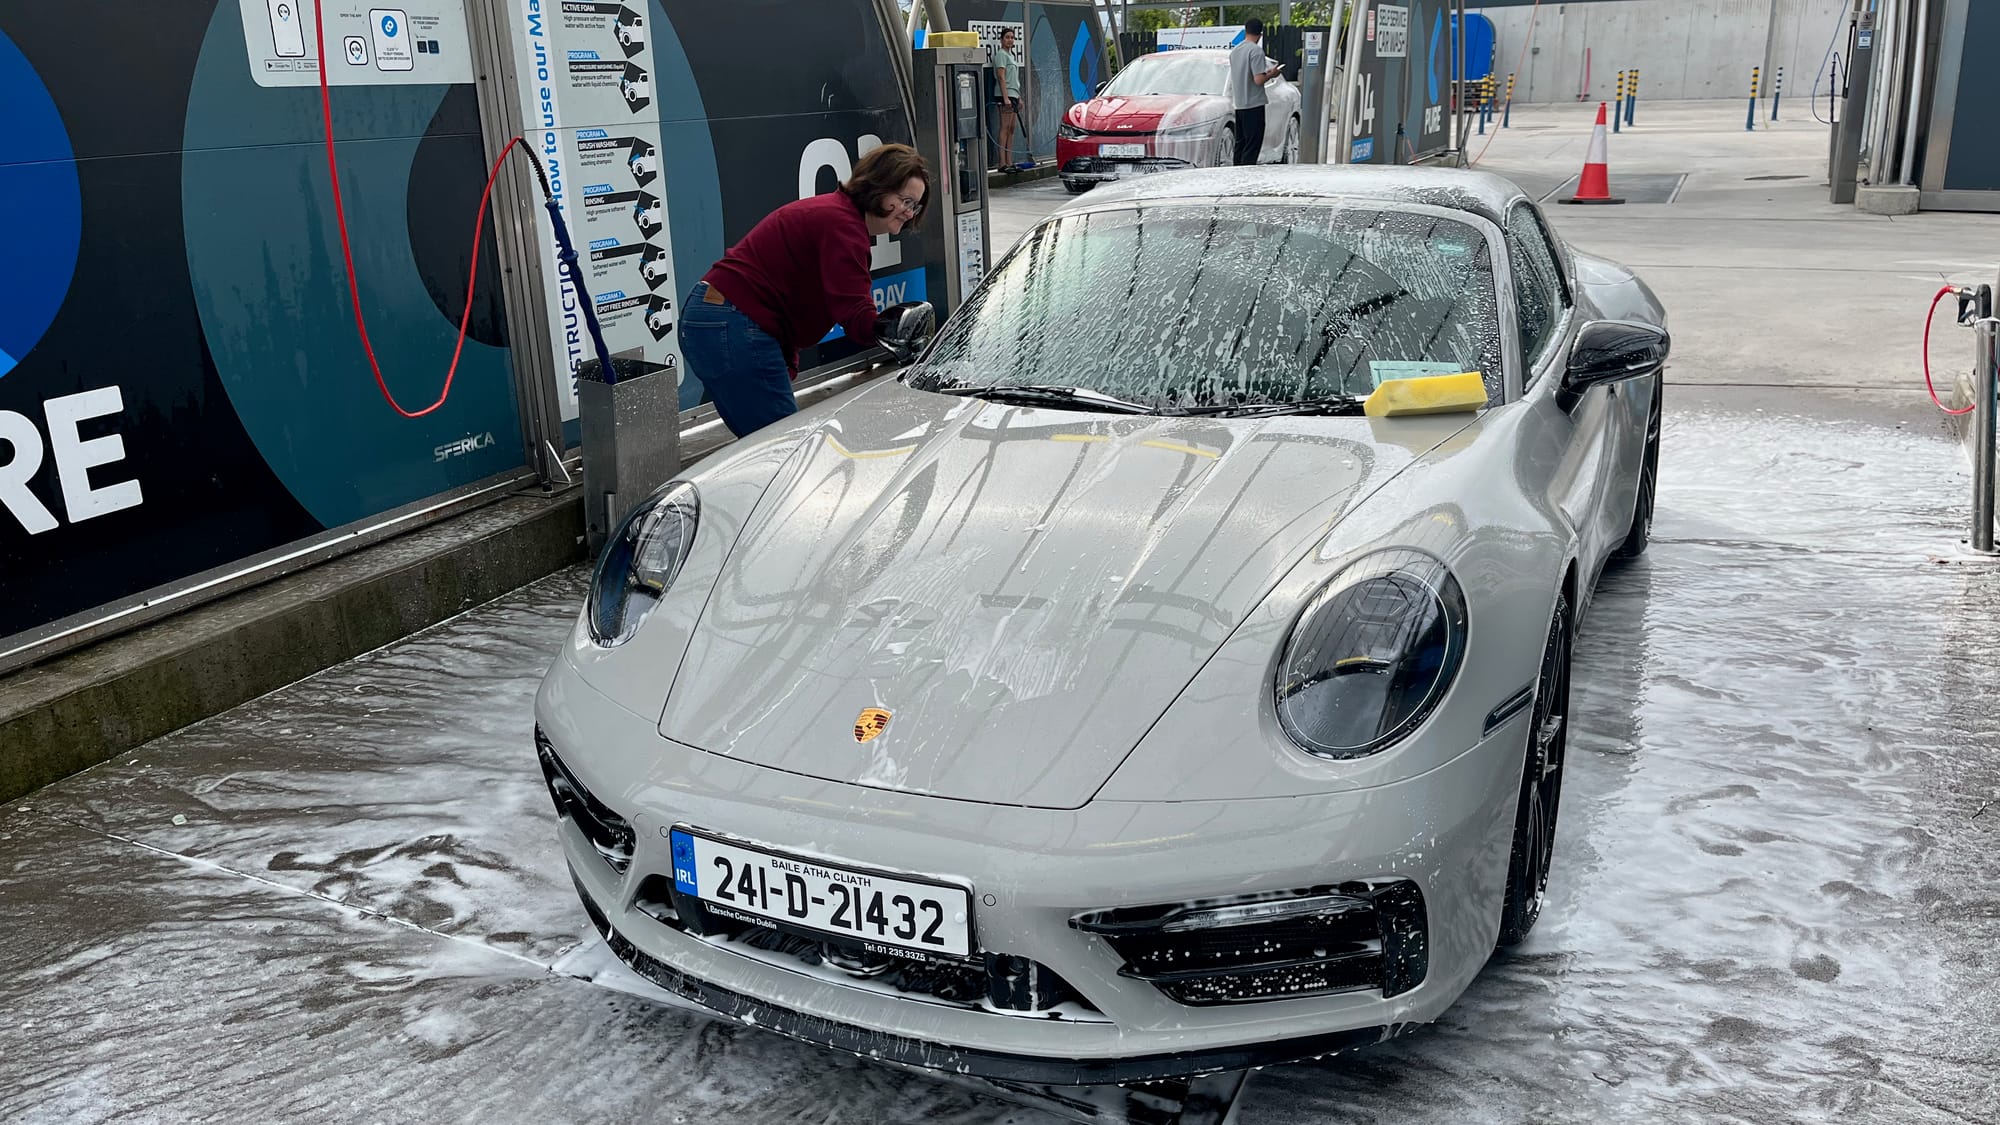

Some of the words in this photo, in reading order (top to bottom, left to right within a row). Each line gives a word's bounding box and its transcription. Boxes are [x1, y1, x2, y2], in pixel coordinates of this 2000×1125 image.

[562, 4, 580, 12] ACTIVE
[992, 26, 1022, 40] SECE
[534, 42, 550, 81] our
[540, 88, 554, 127] use
[1424, 105, 1441, 135] PURE
[545, 132, 556, 155] to
[596, 140, 618, 149] WASHING
[583, 186, 606, 194] PROGRAM
[590, 240, 612, 249] PROGRAM
[591, 252, 603, 260] WAX
[595, 293, 618, 303] PROGRAM
[598, 305, 610, 314] SPOT
[610, 302, 621, 311] FREE
[622, 298, 640, 309] RINSING
[873, 280, 907, 314] BAY
[556, 238, 582, 396] STRUCTIO
[434, 431, 496, 462] SFERICA
[676, 869, 695, 886] IRL
[772, 859, 800, 873] BAILE
[803, 865, 831, 880] ÁTHA
[833, 873, 871, 887] CLIATH
[714, 856, 946, 946] 241-D-21432
[710, 905, 734, 919] Porsche
[735, 912, 756, 924] Centre
[756, 919, 777, 930] Dublin
[877, 946, 887, 954] 01
[889, 948, 904, 957] 235
[905, 951, 926, 961] 3375
